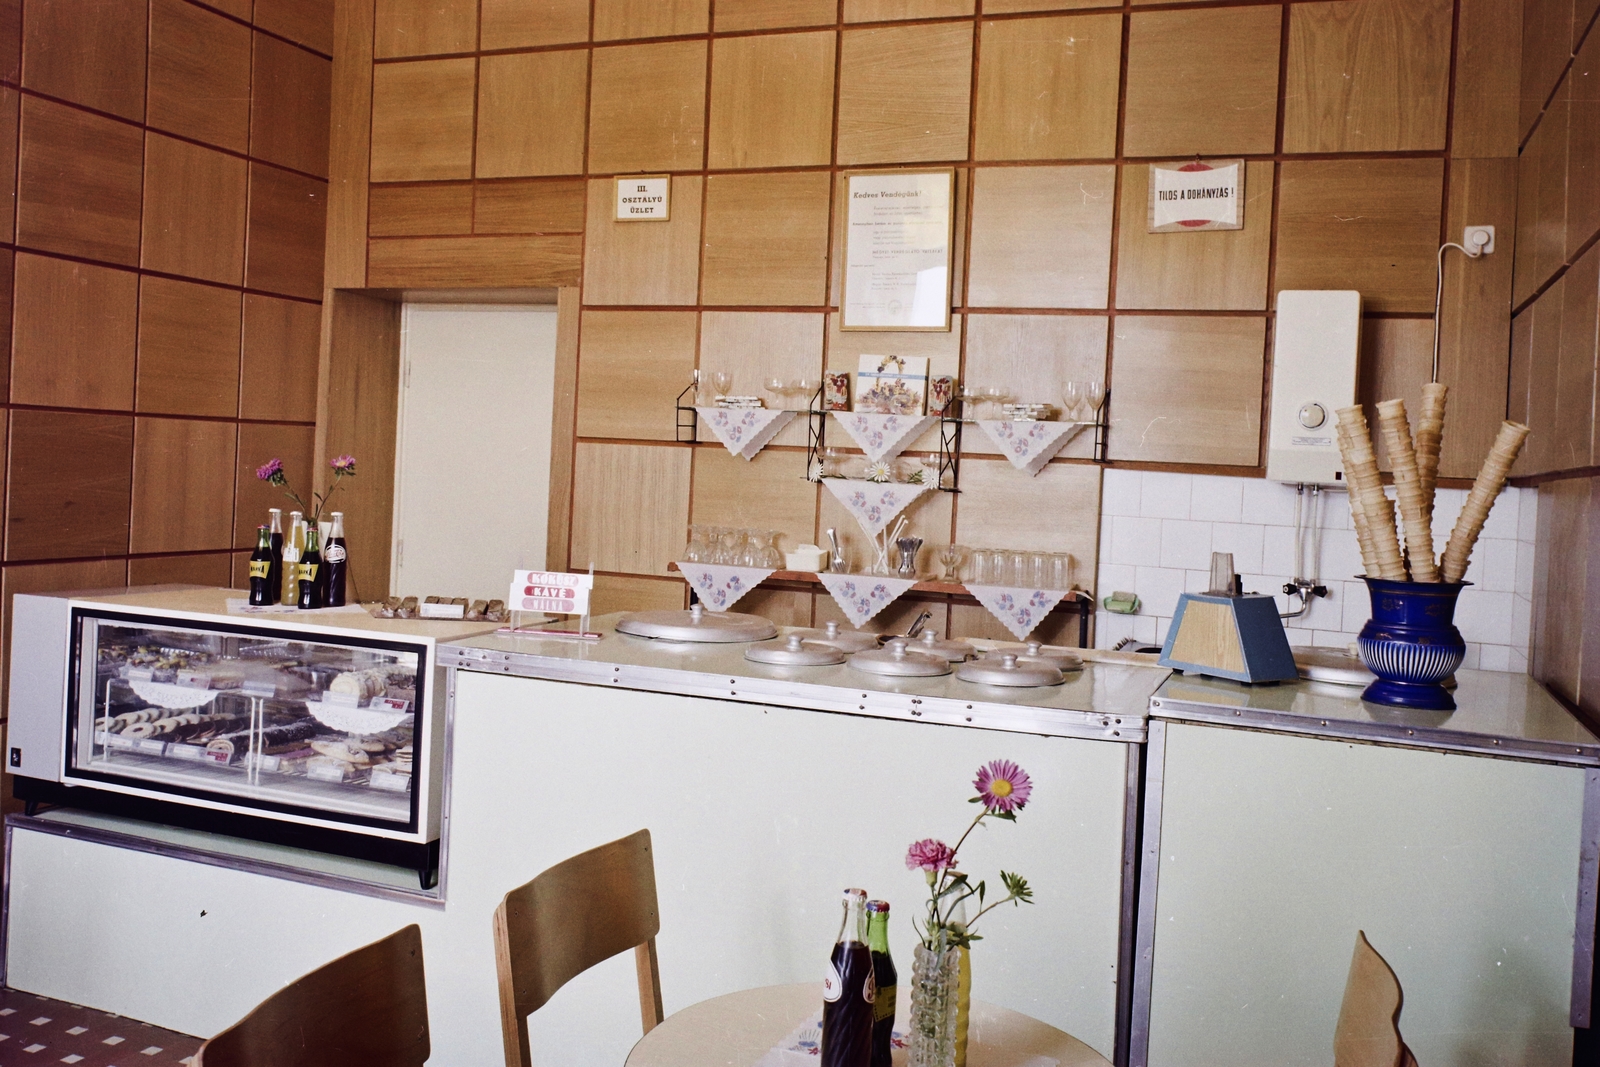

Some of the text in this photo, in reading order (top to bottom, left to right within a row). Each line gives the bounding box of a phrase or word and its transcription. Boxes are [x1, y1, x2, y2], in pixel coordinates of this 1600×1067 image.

[637, 185, 648, 193] III.
[853, 191, 879, 199] Kedves
[1158, 189, 1178, 201] TILOS
[1180, 189, 1185, 200] A
[1187, 187, 1229, 200] DOHÁNYZÁS
[622, 195, 663, 203] OSZTÁLYÚ
[630, 206, 654, 214] ÜZLET
